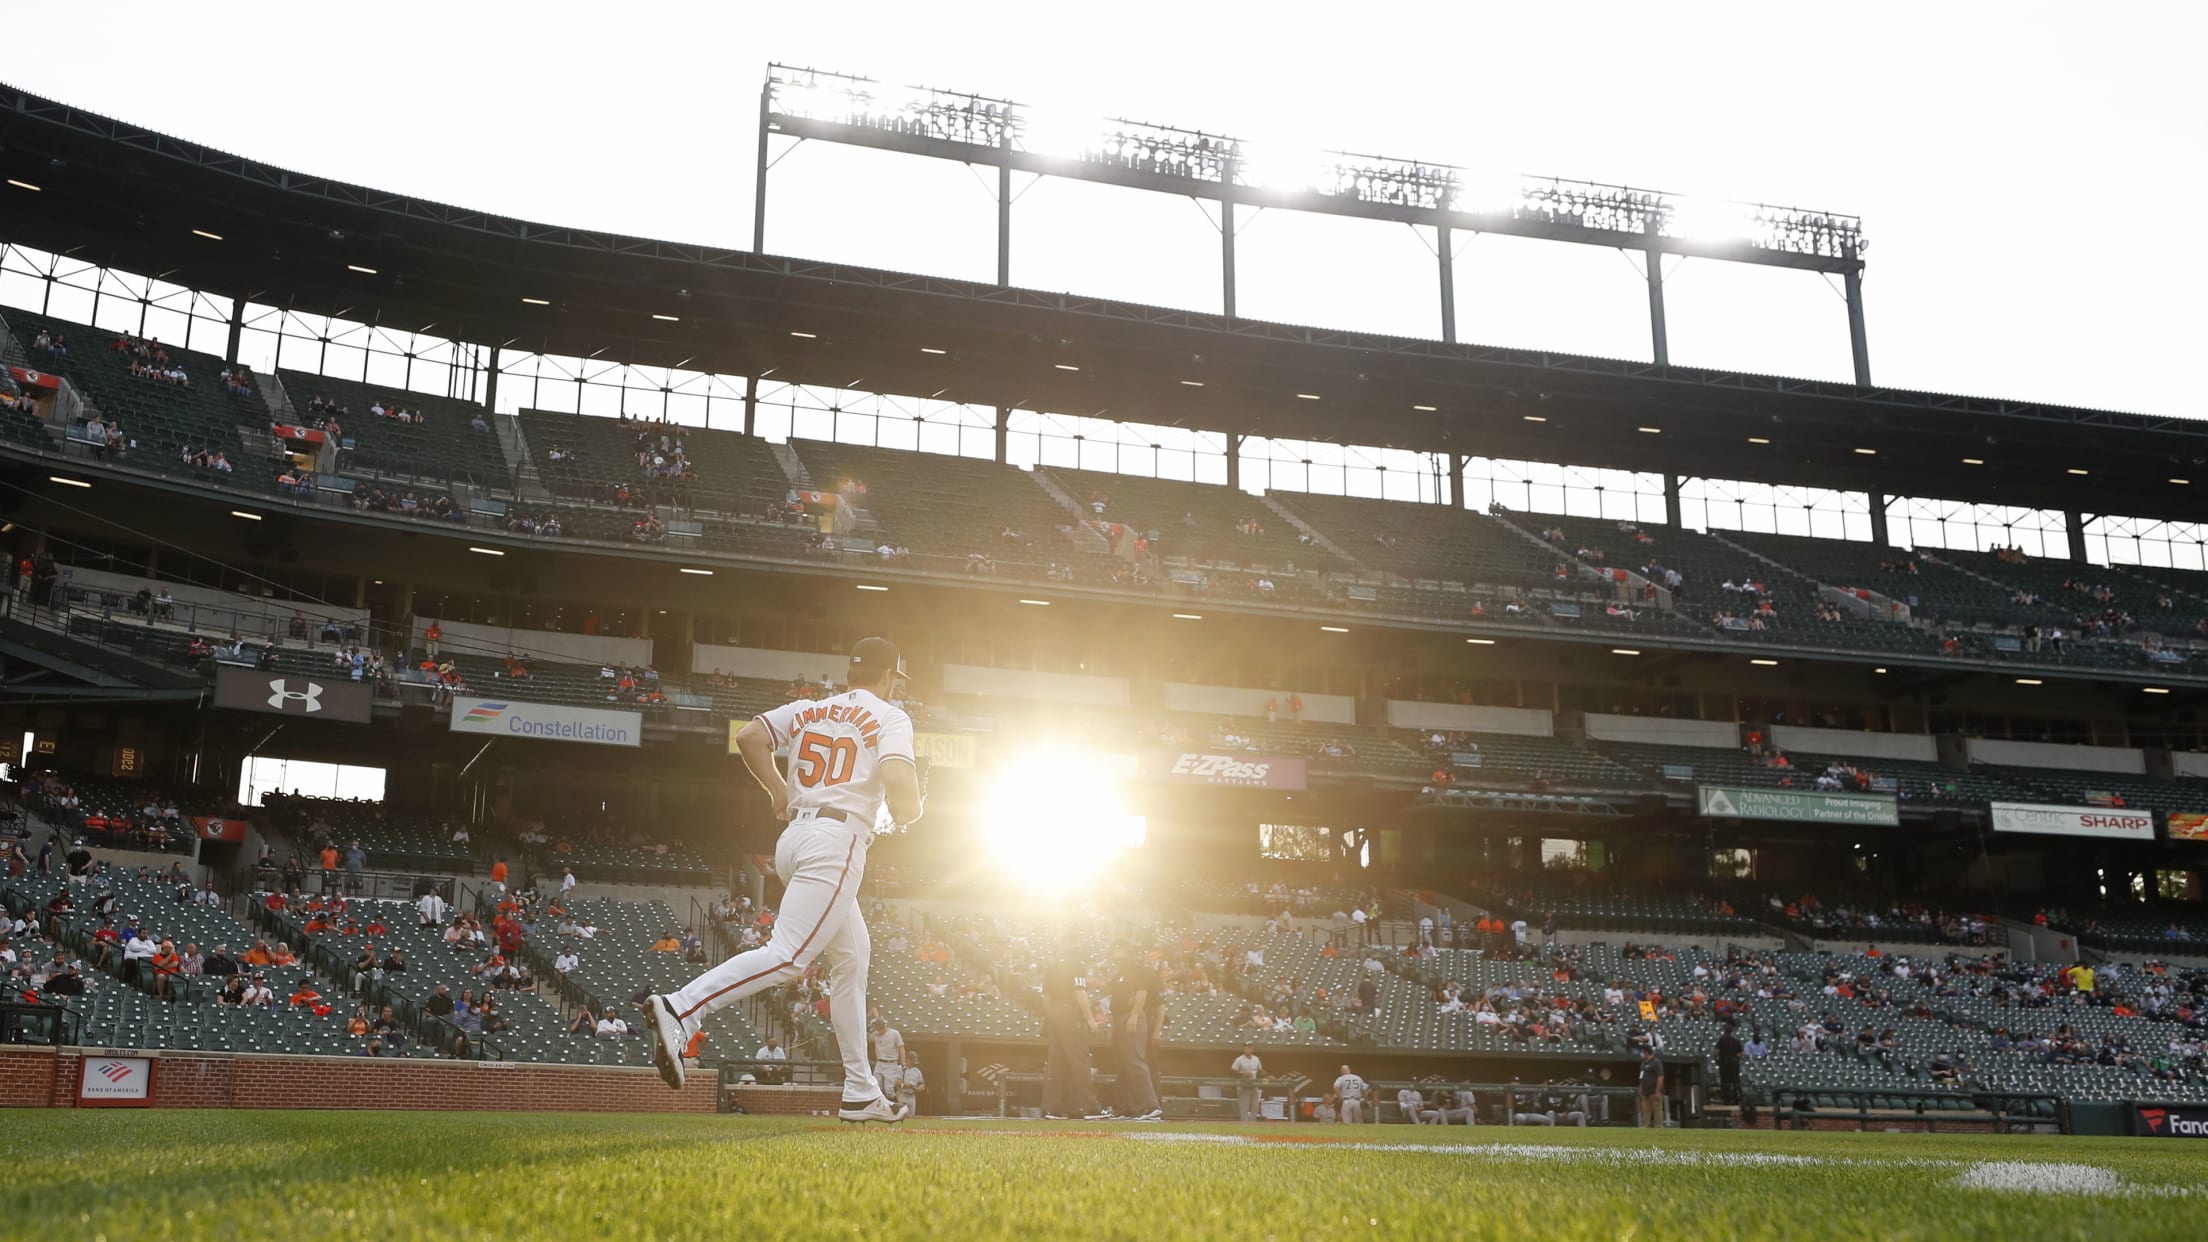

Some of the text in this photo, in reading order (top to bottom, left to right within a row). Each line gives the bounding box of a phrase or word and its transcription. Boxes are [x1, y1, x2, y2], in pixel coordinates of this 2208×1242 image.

[509, 715, 627, 742] Constellation
[797, 730, 858, 788] 50
[1740, 789, 1801, 805] ADVANCED
[1825, 797, 1881, 810] Proud Imaging
[1740, 801, 1804, 818] RADIOLOGY
[1814, 808, 1895, 824] Partner of the Orioles
[2080, 815, 2148, 830] SHARP
[1344, 1079, 1360, 1090] 75
